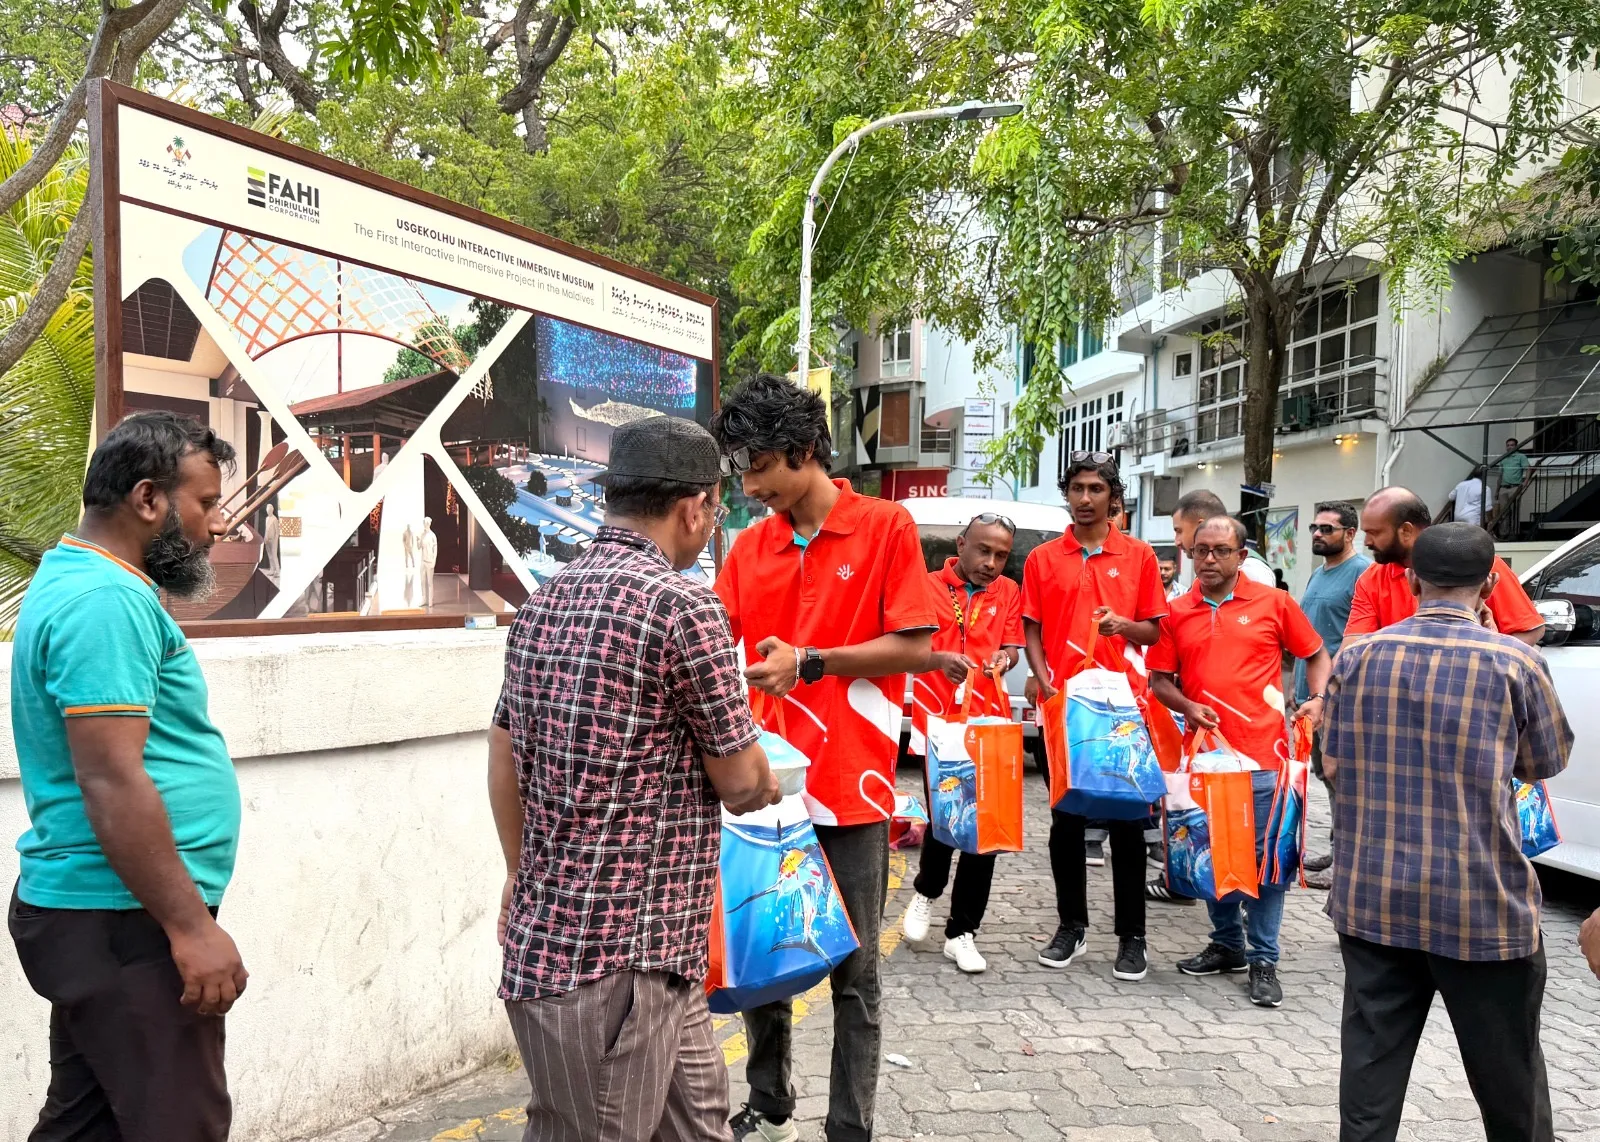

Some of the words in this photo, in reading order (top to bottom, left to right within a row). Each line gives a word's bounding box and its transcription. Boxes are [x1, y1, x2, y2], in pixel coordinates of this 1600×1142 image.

[269, 173, 319, 208] FAHI
[269, 196, 319, 217] DHIRIULHUN
[269, 205, 320, 224] CORPORATION
[353, 222, 374, 238] The
[376, 229, 398, 246] First
[401, 236, 455, 263] Interactive
[457, 257, 504, 278] Immersive
[506, 269, 535, 289] Project
[537, 279, 545, 290] in
[547, 281, 560, 295] the
[562, 285, 595, 306] Maldives
[396, 218, 455, 246] USGEKOLHU
[457, 236, 515, 265] INTERACTIVE
[516, 255, 560, 280] IMMERSIVE
[562, 272, 594, 291] MUSEUM
